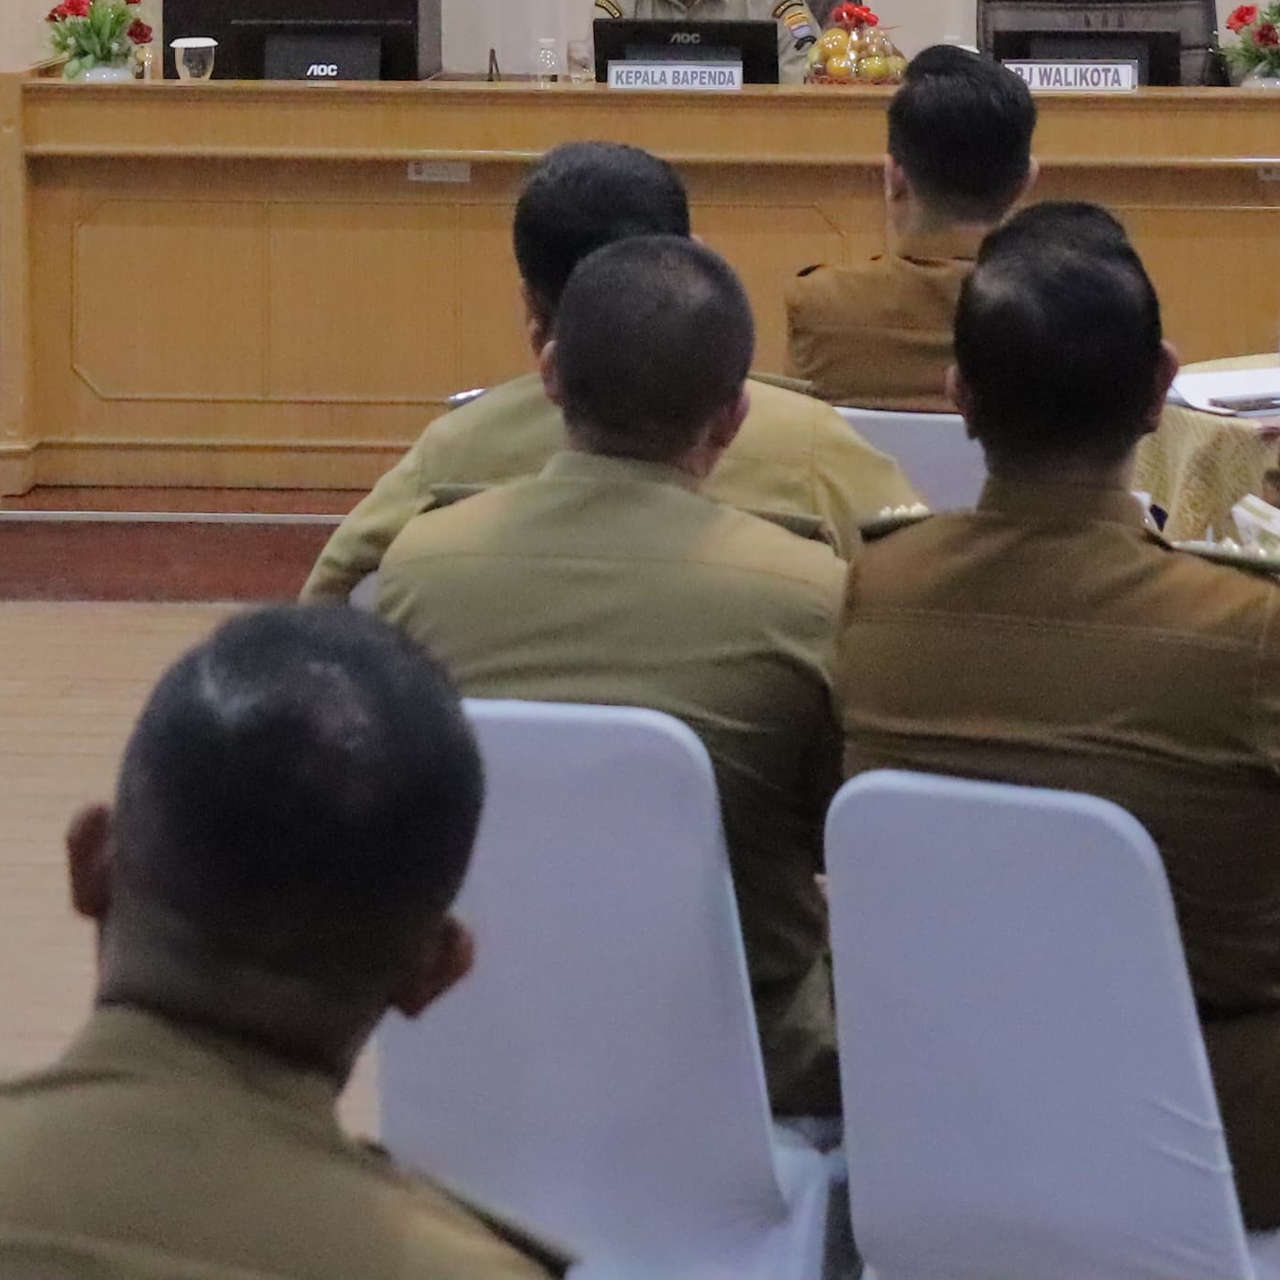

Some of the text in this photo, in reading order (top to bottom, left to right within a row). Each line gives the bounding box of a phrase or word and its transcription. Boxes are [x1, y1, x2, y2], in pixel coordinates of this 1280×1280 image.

[670, 33, 701, 45] AOC
[306, 64, 338, 76] AOC
[1038, 67, 1122, 86] WALIKOTA
[615, 69, 736, 87] KEPALA BAPENDA
